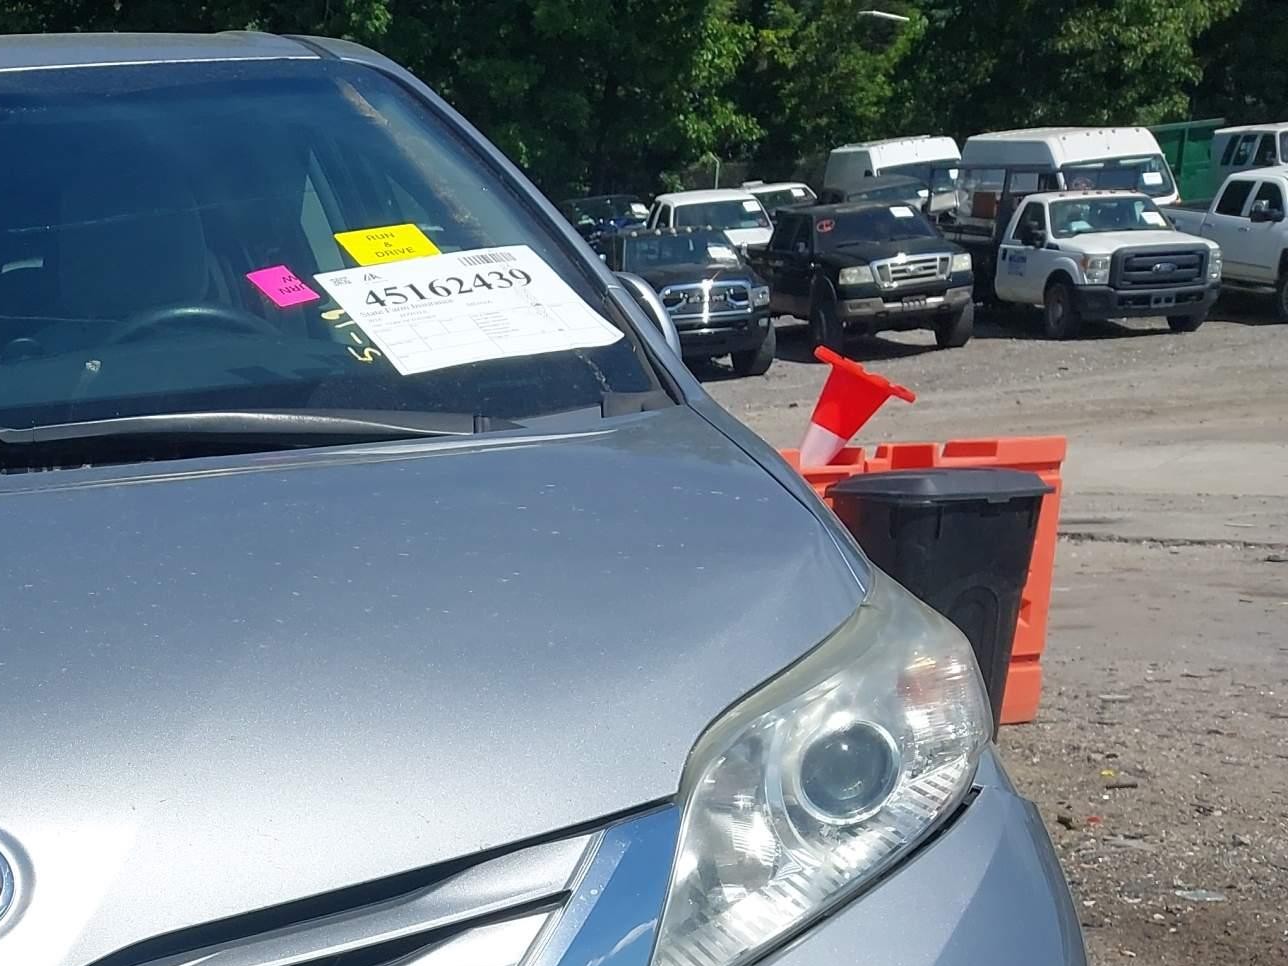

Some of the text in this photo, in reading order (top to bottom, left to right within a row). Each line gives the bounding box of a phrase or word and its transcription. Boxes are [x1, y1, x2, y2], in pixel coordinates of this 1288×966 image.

[365, 231, 395, 241] RUN
[375, 246, 416, 258] DRIVE
[365, 268, 532, 307] 45162439
